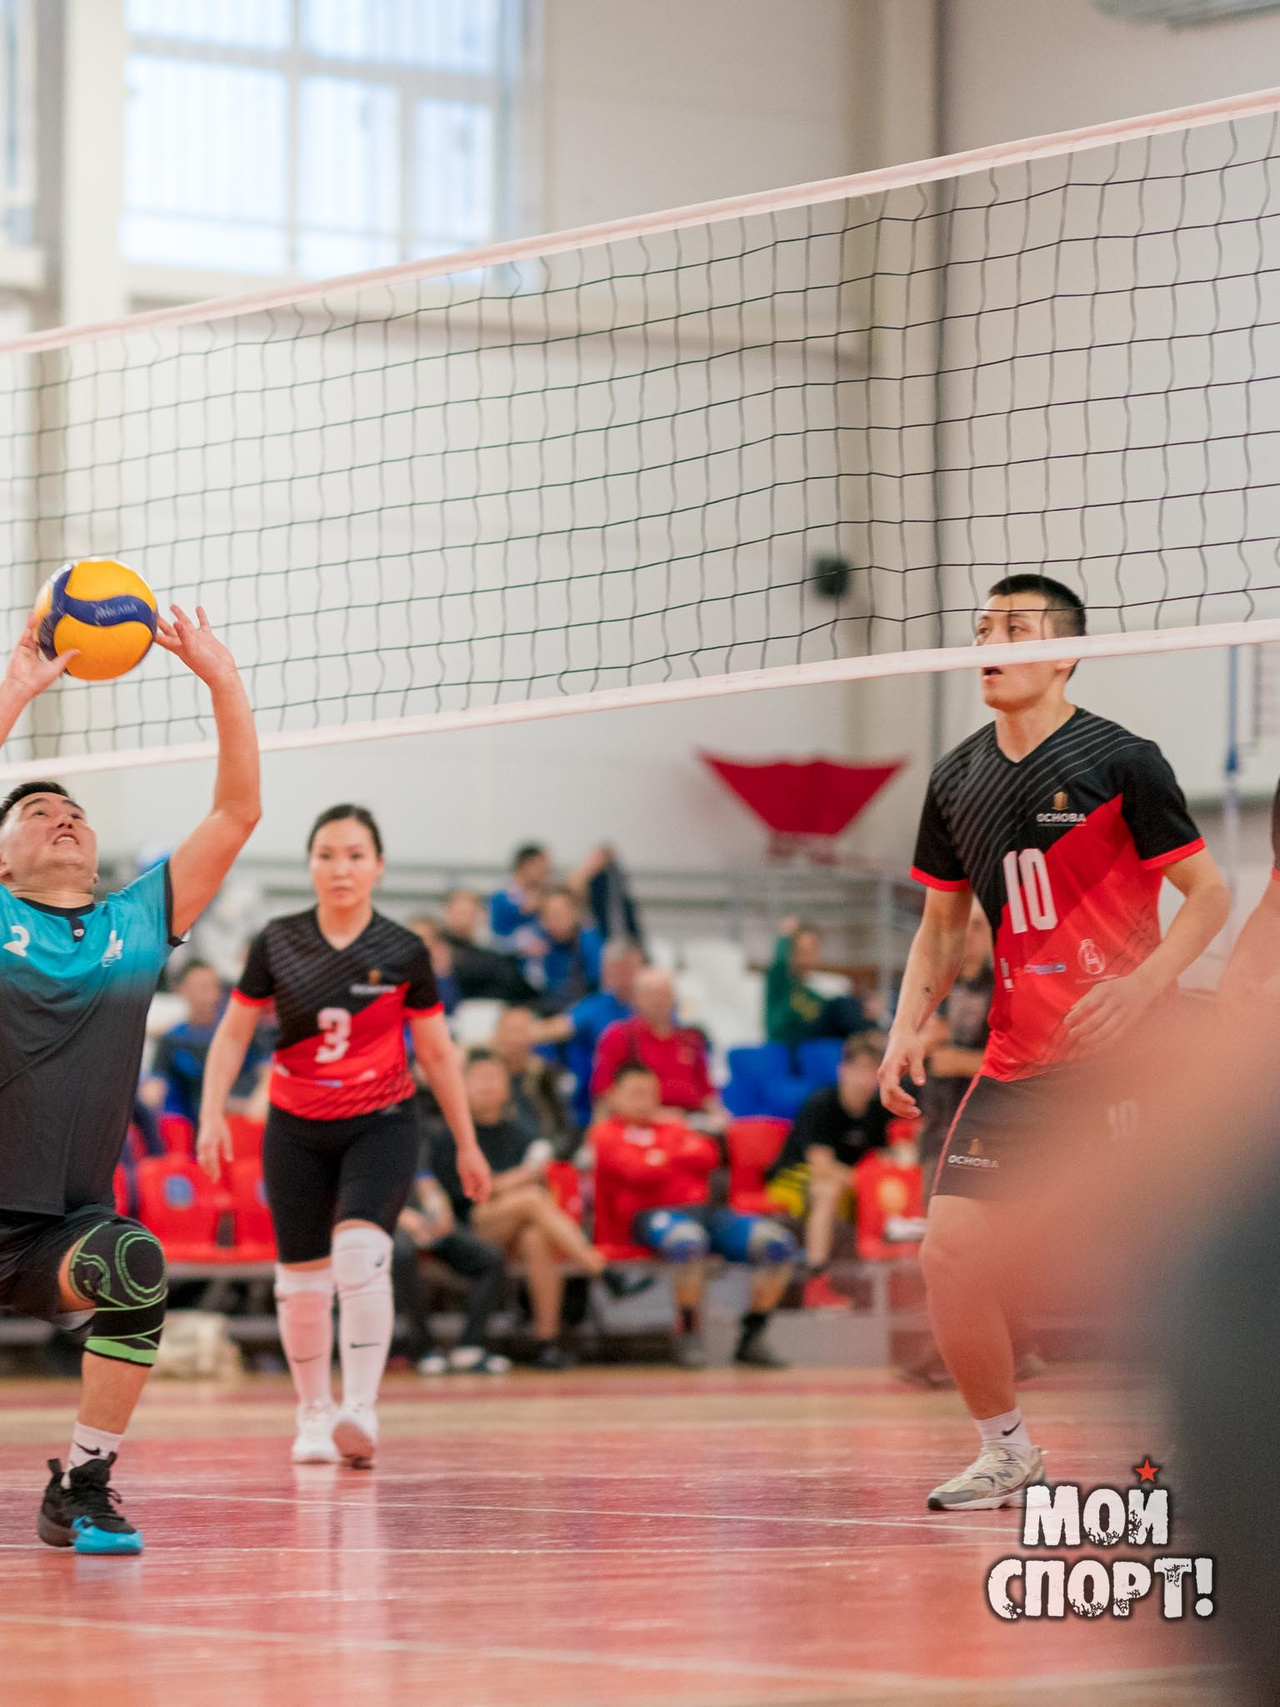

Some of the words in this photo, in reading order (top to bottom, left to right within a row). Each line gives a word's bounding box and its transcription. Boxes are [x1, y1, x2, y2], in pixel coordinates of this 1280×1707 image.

[1036, 813, 1087, 823] ОСНОВА
[1002, 848, 1059, 934] 10
[2, 925, 31, 958] 2
[314, 1007, 352, 1064] 3
